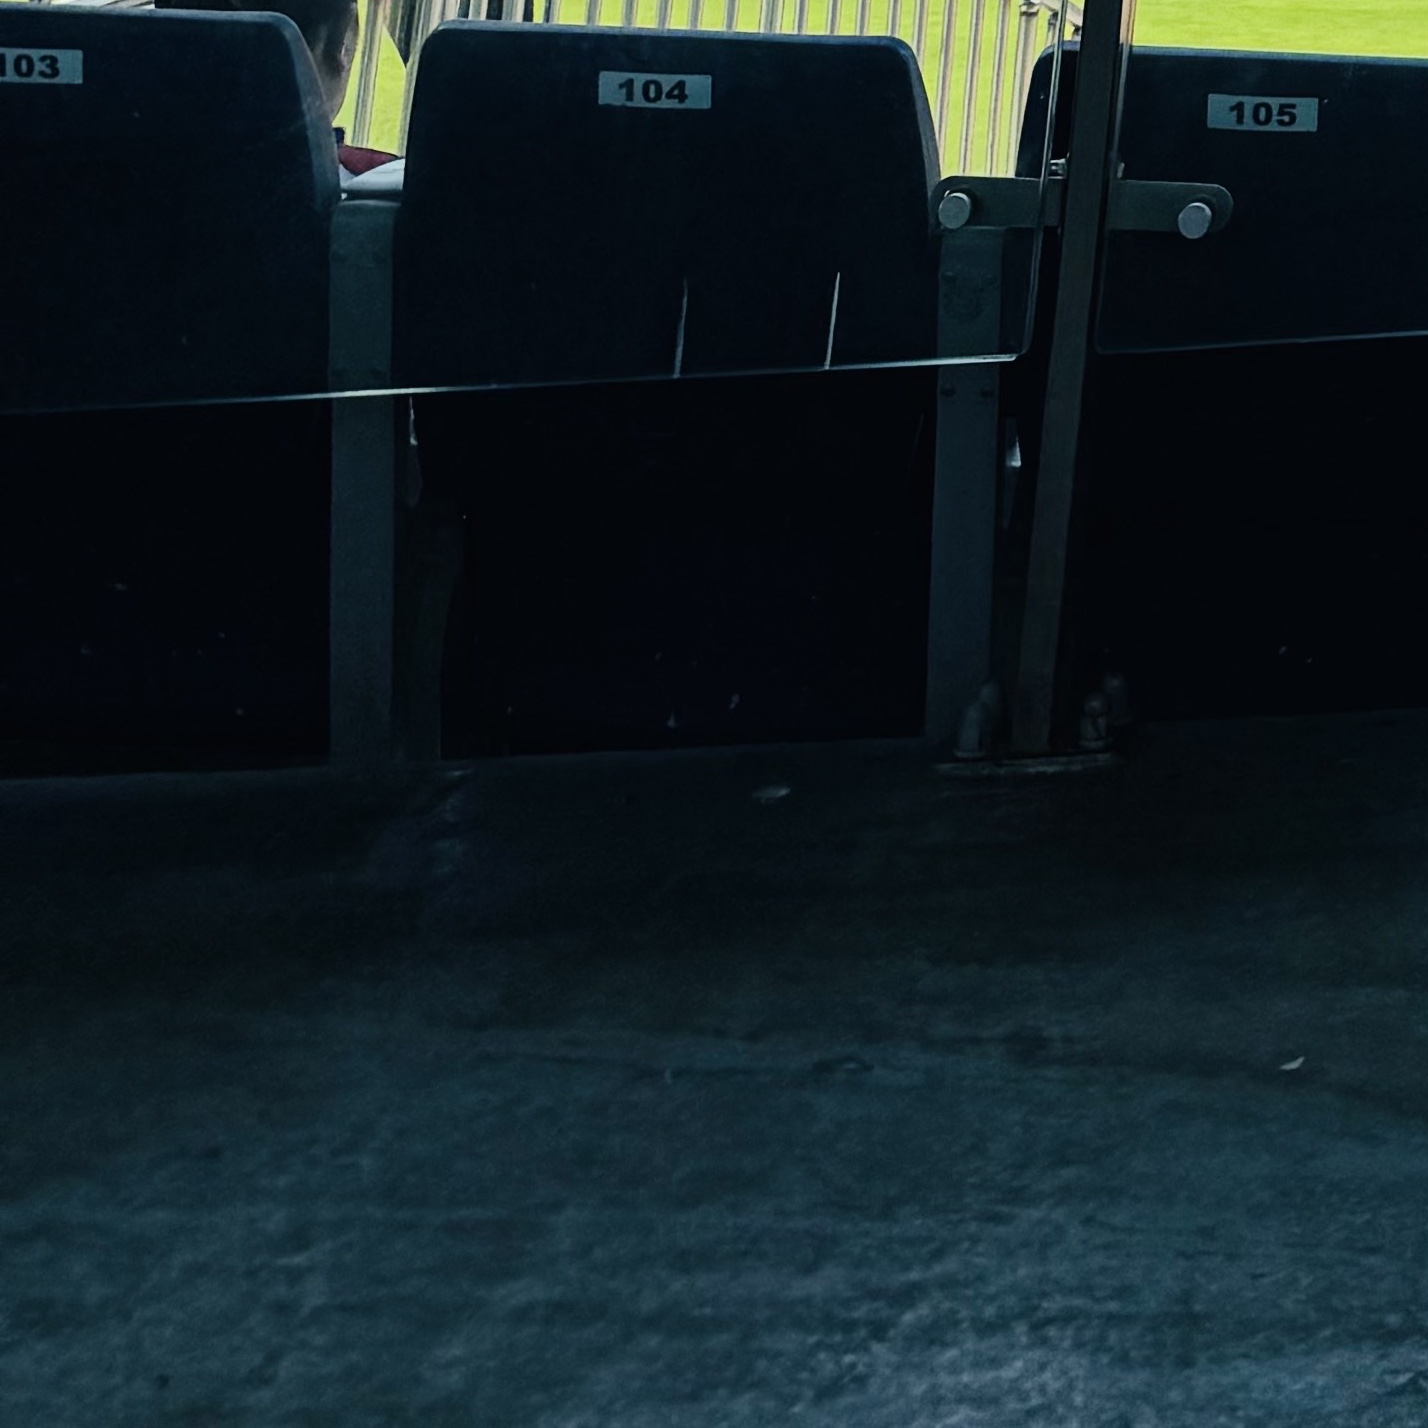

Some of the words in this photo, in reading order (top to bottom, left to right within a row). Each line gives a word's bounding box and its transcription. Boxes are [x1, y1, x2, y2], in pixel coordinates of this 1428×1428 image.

[1, 53, 61, 80] 103
[617, 79, 689, 106] 104
[1228, 100, 1298, 129] 105
